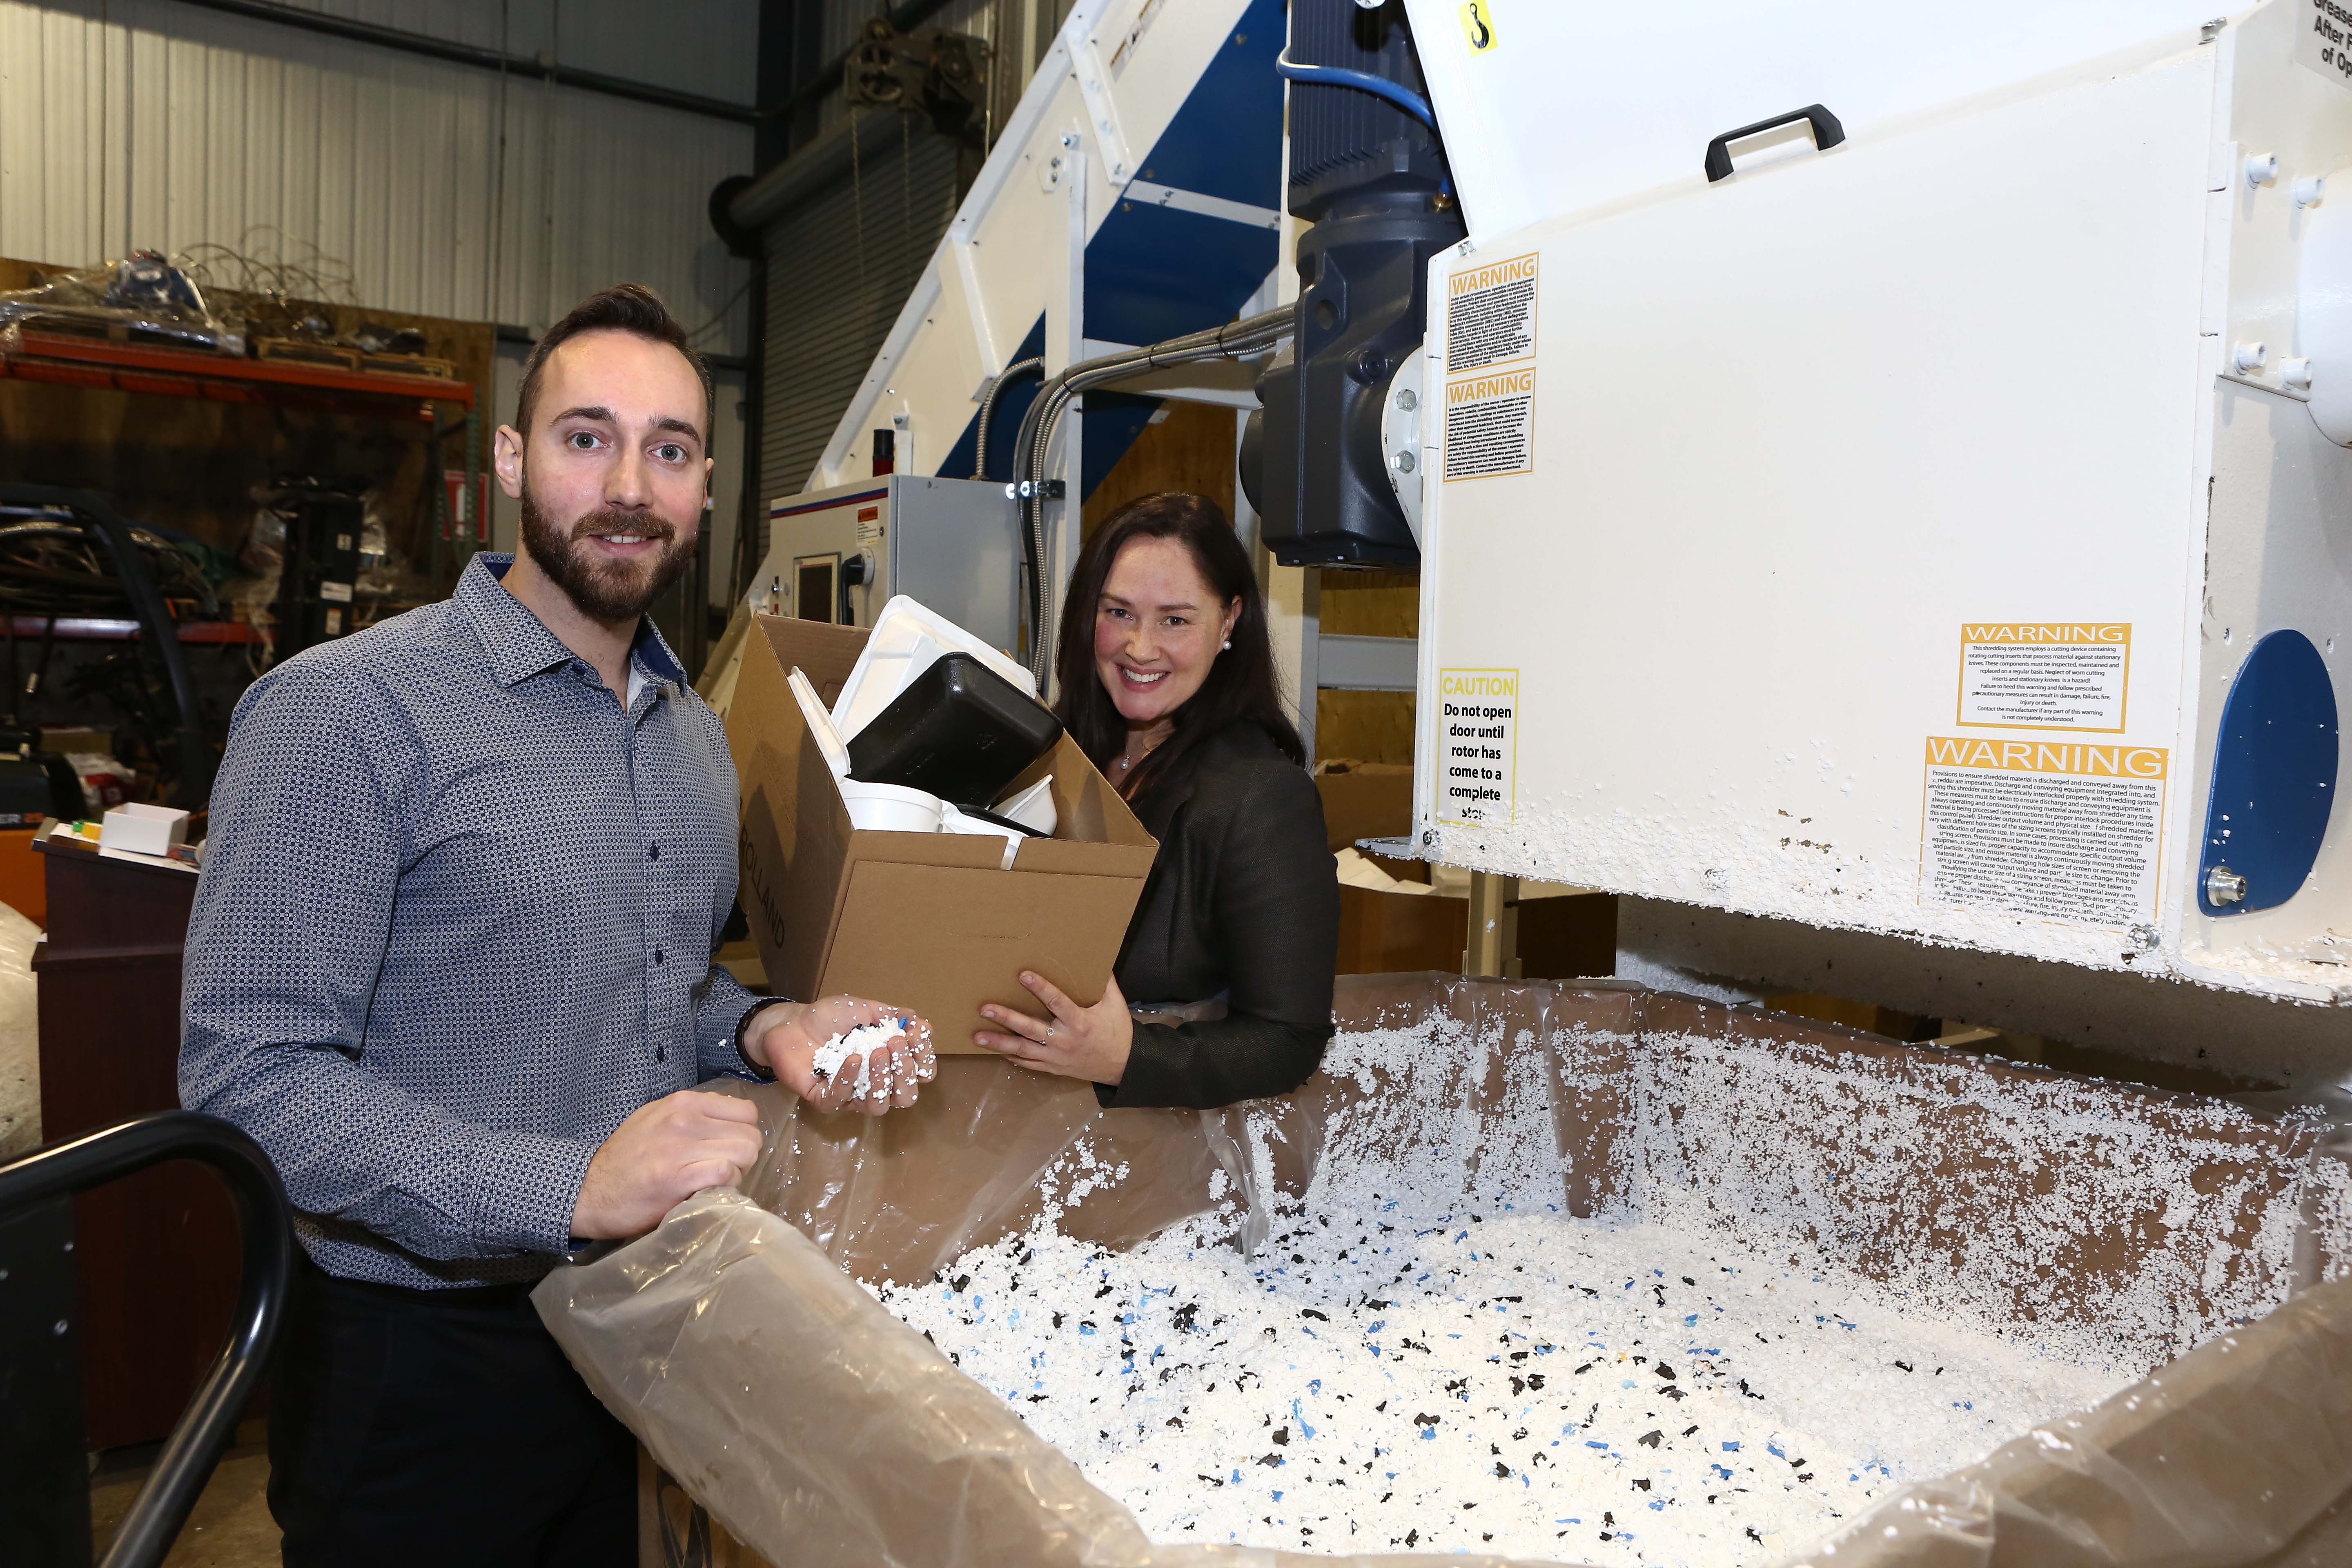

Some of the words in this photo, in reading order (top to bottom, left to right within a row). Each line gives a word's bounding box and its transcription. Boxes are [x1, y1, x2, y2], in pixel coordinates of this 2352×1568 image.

[2314, 15, 2344, 46] After
[2322, 47, 2334, 65] of
[1452, 258, 1535, 295] WARNING
[1450, 373, 1531, 404] WARNING
[1966, 626, 2123, 641] WARNING
[1443, 677, 1514, 696] CAUTION
[1444, 703, 1459, 716] Do
[1462, 705, 1480, 717] not
[1483, 707, 1511, 720] open
[1450, 724, 1476, 737] door
[1478, 725, 1504, 738] until
[1452, 745, 1479, 758] rotor
[1482, 745, 1501, 759] has
[1929, 738, 2162, 777] WARNING
[1450, 766, 1478, 778] come
[1481, 767, 1493, 779] to
[1495, 770, 1502, 780] a
[2038, 777, 2069, 786] discharged
[1450, 786, 1501, 801] complete
[1994, 781, 2021, 790] Discharge
[2033, 785, 2062, 793] conveying
[2096, 788, 2127, 797] integrated
[2003, 789, 2032, 797] electrically
[2105, 797, 2136, 806] shredding
[739, 824, 784, 949] ROLLAND
